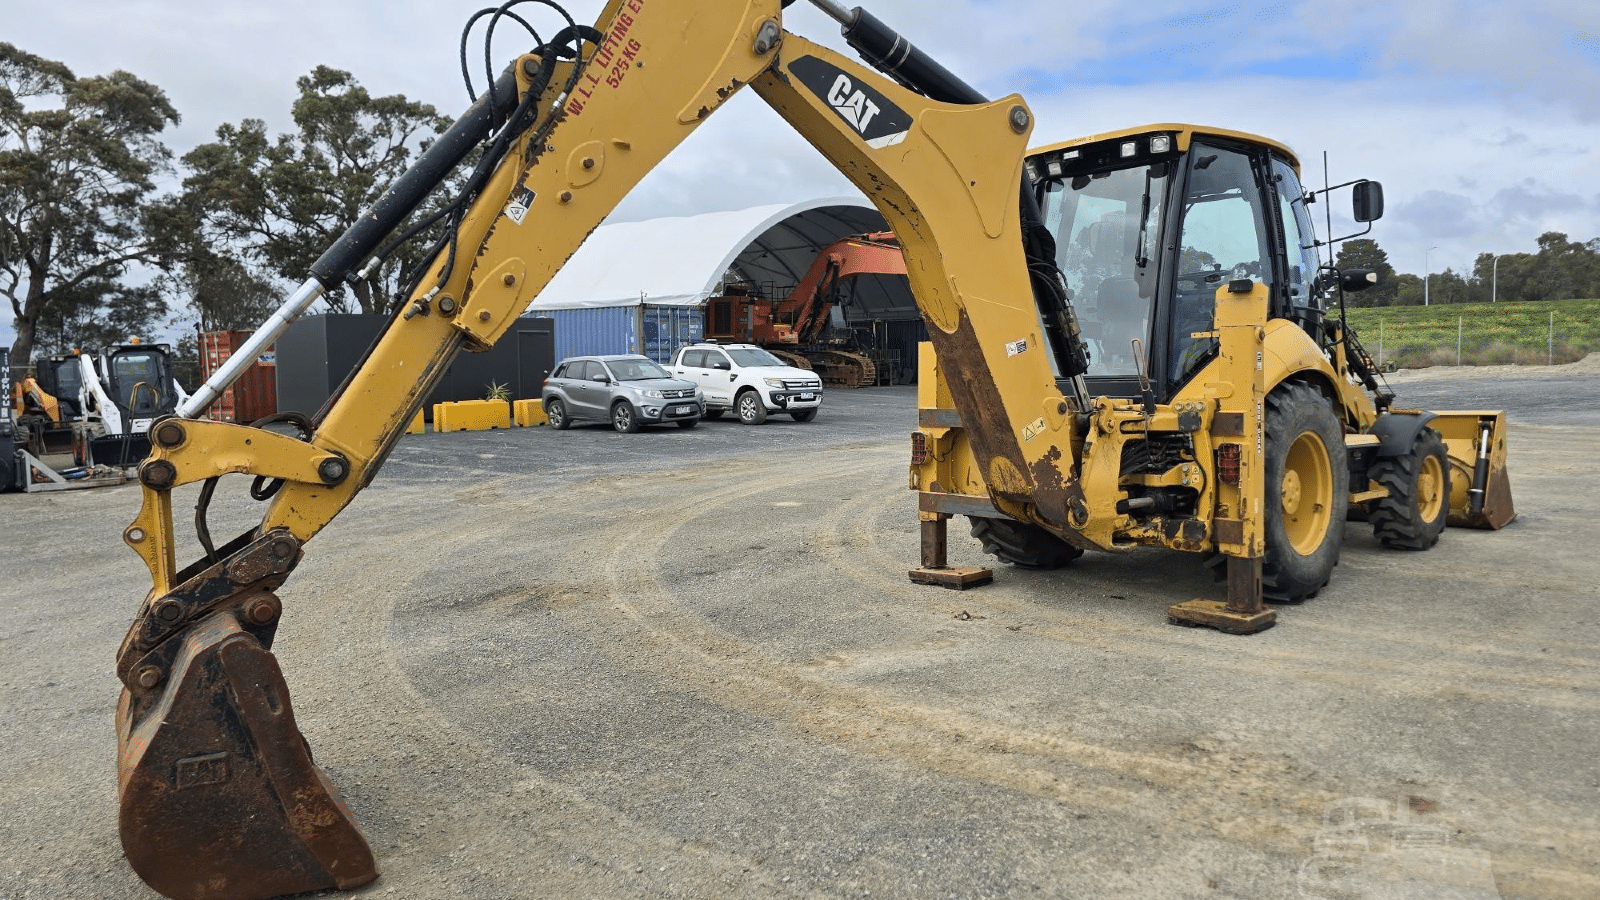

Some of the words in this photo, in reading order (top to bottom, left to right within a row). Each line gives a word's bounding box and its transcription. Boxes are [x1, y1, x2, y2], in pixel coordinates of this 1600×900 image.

[595, 13, 635, 69] LIFTING
[606, 57, 630, 89] 525
[622, 38, 642, 61] KG
[827, 73, 881, 134] CAT
